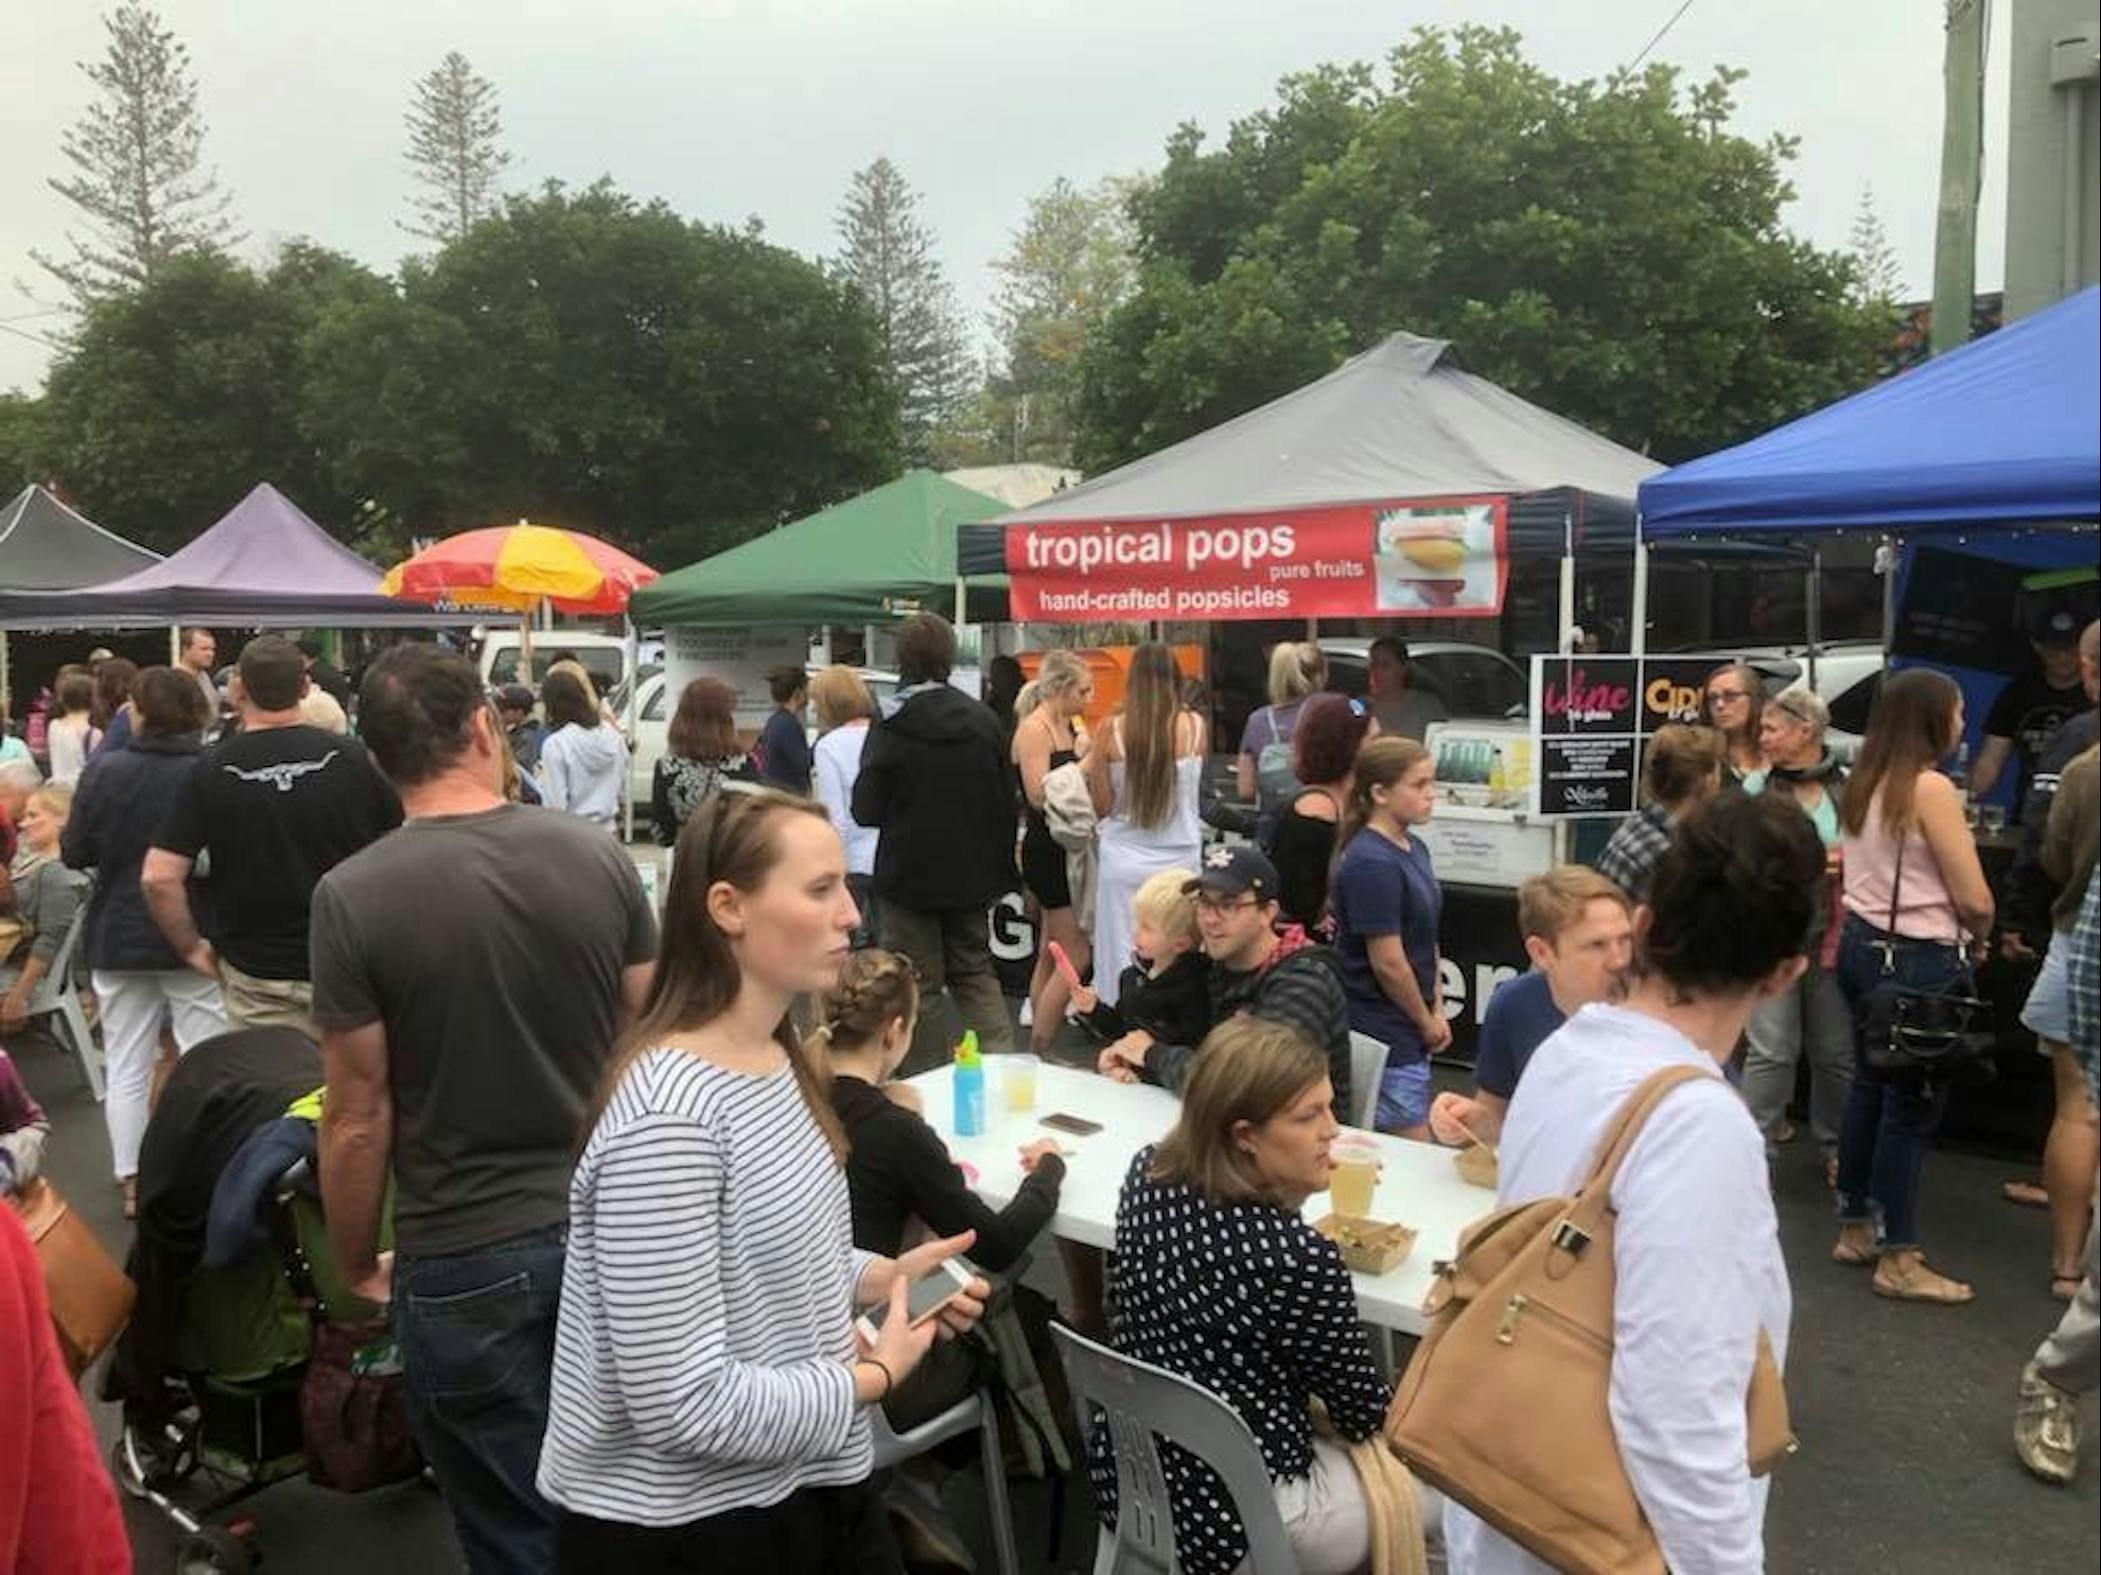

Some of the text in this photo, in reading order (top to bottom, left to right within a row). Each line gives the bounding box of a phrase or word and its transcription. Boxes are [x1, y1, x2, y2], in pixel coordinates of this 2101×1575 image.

[1026, 523, 1296, 574] tropical pops
[1269, 559, 1364, 582] pure fruits
[1039, 585, 1290, 613] hand-crafted popsicles
